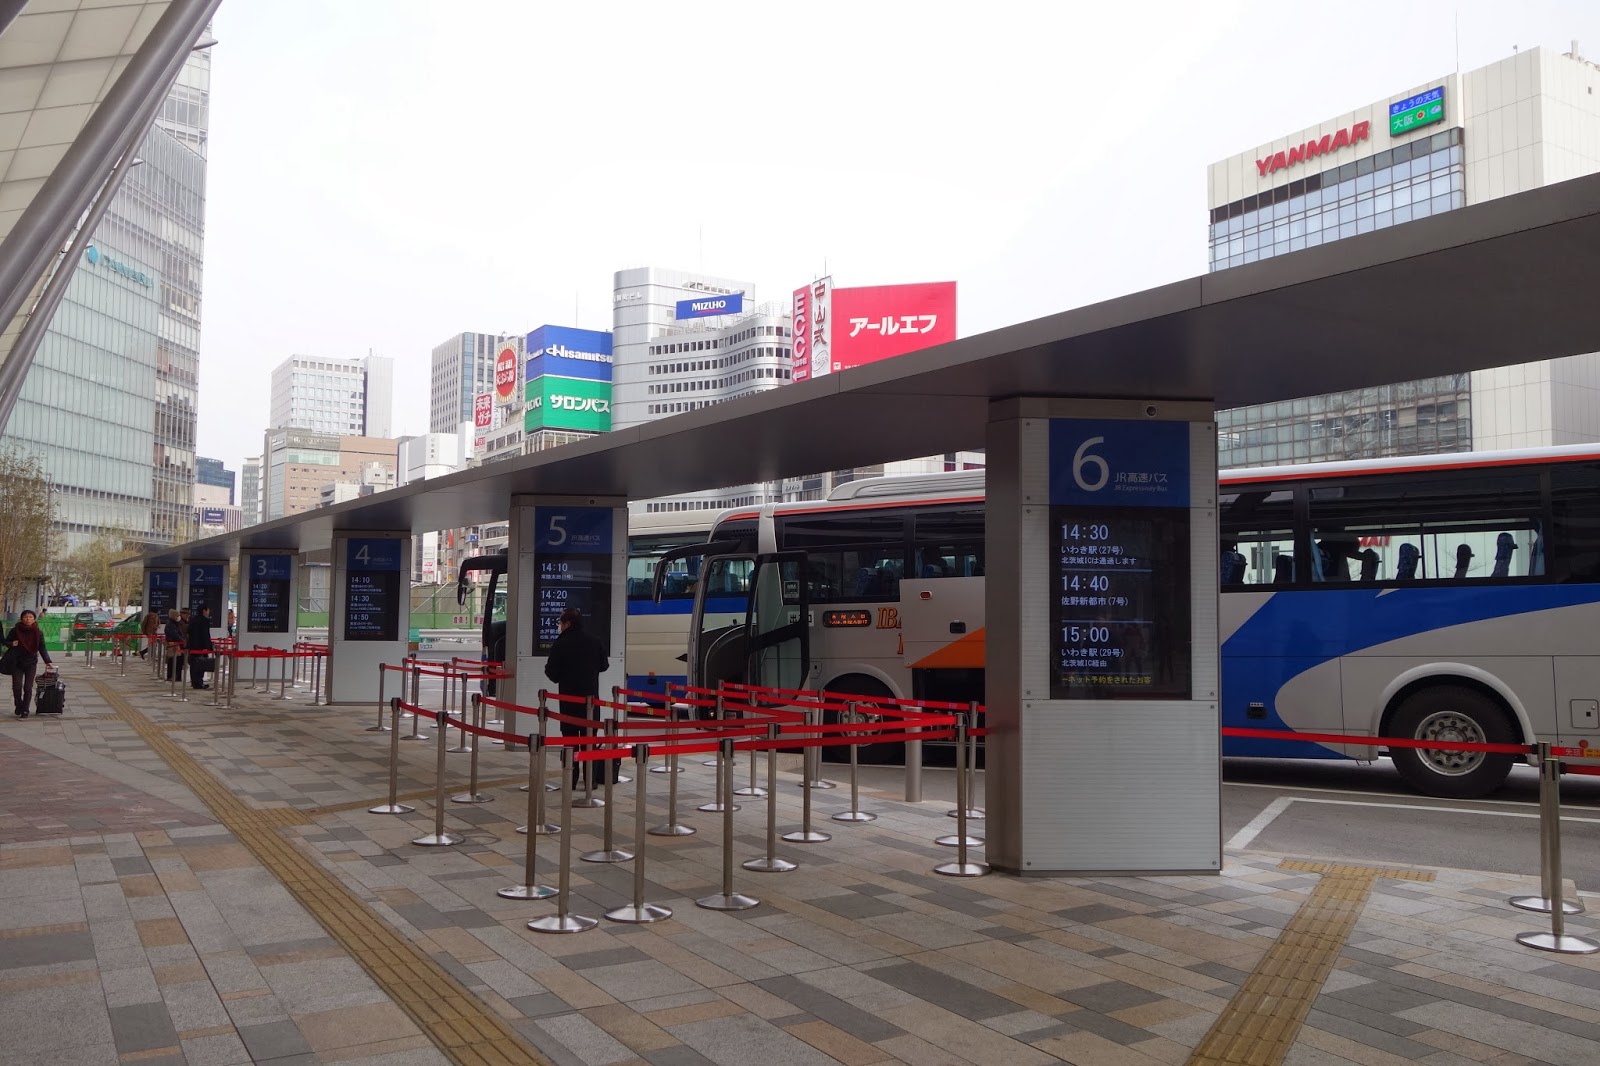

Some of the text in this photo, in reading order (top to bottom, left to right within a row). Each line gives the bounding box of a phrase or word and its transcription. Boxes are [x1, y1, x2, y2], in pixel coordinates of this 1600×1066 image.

[1392, 89, 1441, 114] きょうの天気
[1393, 113, 1414, 130] 大阪
[1255, 120, 1370, 177] YANMAR
[692, 300, 726, 312] MIZUHO
[813, 281, 827, 348] 中山式
[793, 293, 806, 358] ECC
[849, 314, 938, 338] アールエフ
[545, 344, 613, 364] Hisamitsu
[476, 396, 491, 410] 未来
[549, 394, 610, 414] サロンパス
[1072, 436, 1110, 492] 6
[1114, 472, 1168, 483] JR高速バス
[1122, 485, 1156, 493] Expressway
[547, 515, 568, 546] 5
[1061, 524, 1109, 540] 14:30
[354, 544, 371, 566] 4
[195, 568, 205, 582] 2
[256, 559, 267, 576] 3
[541, 562, 568, 572] 14:10
[155, 574, 161, 586] 1
[351, 576, 371, 584] 14:10
[1061, 575, 1110, 591] 14:40
[541, 590, 568, 600] 14:20
[349, 613, 369, 621] 14:50
[541, 617, 561, 627] 14:3
[1061, 626, 1110, 642] 15:00
